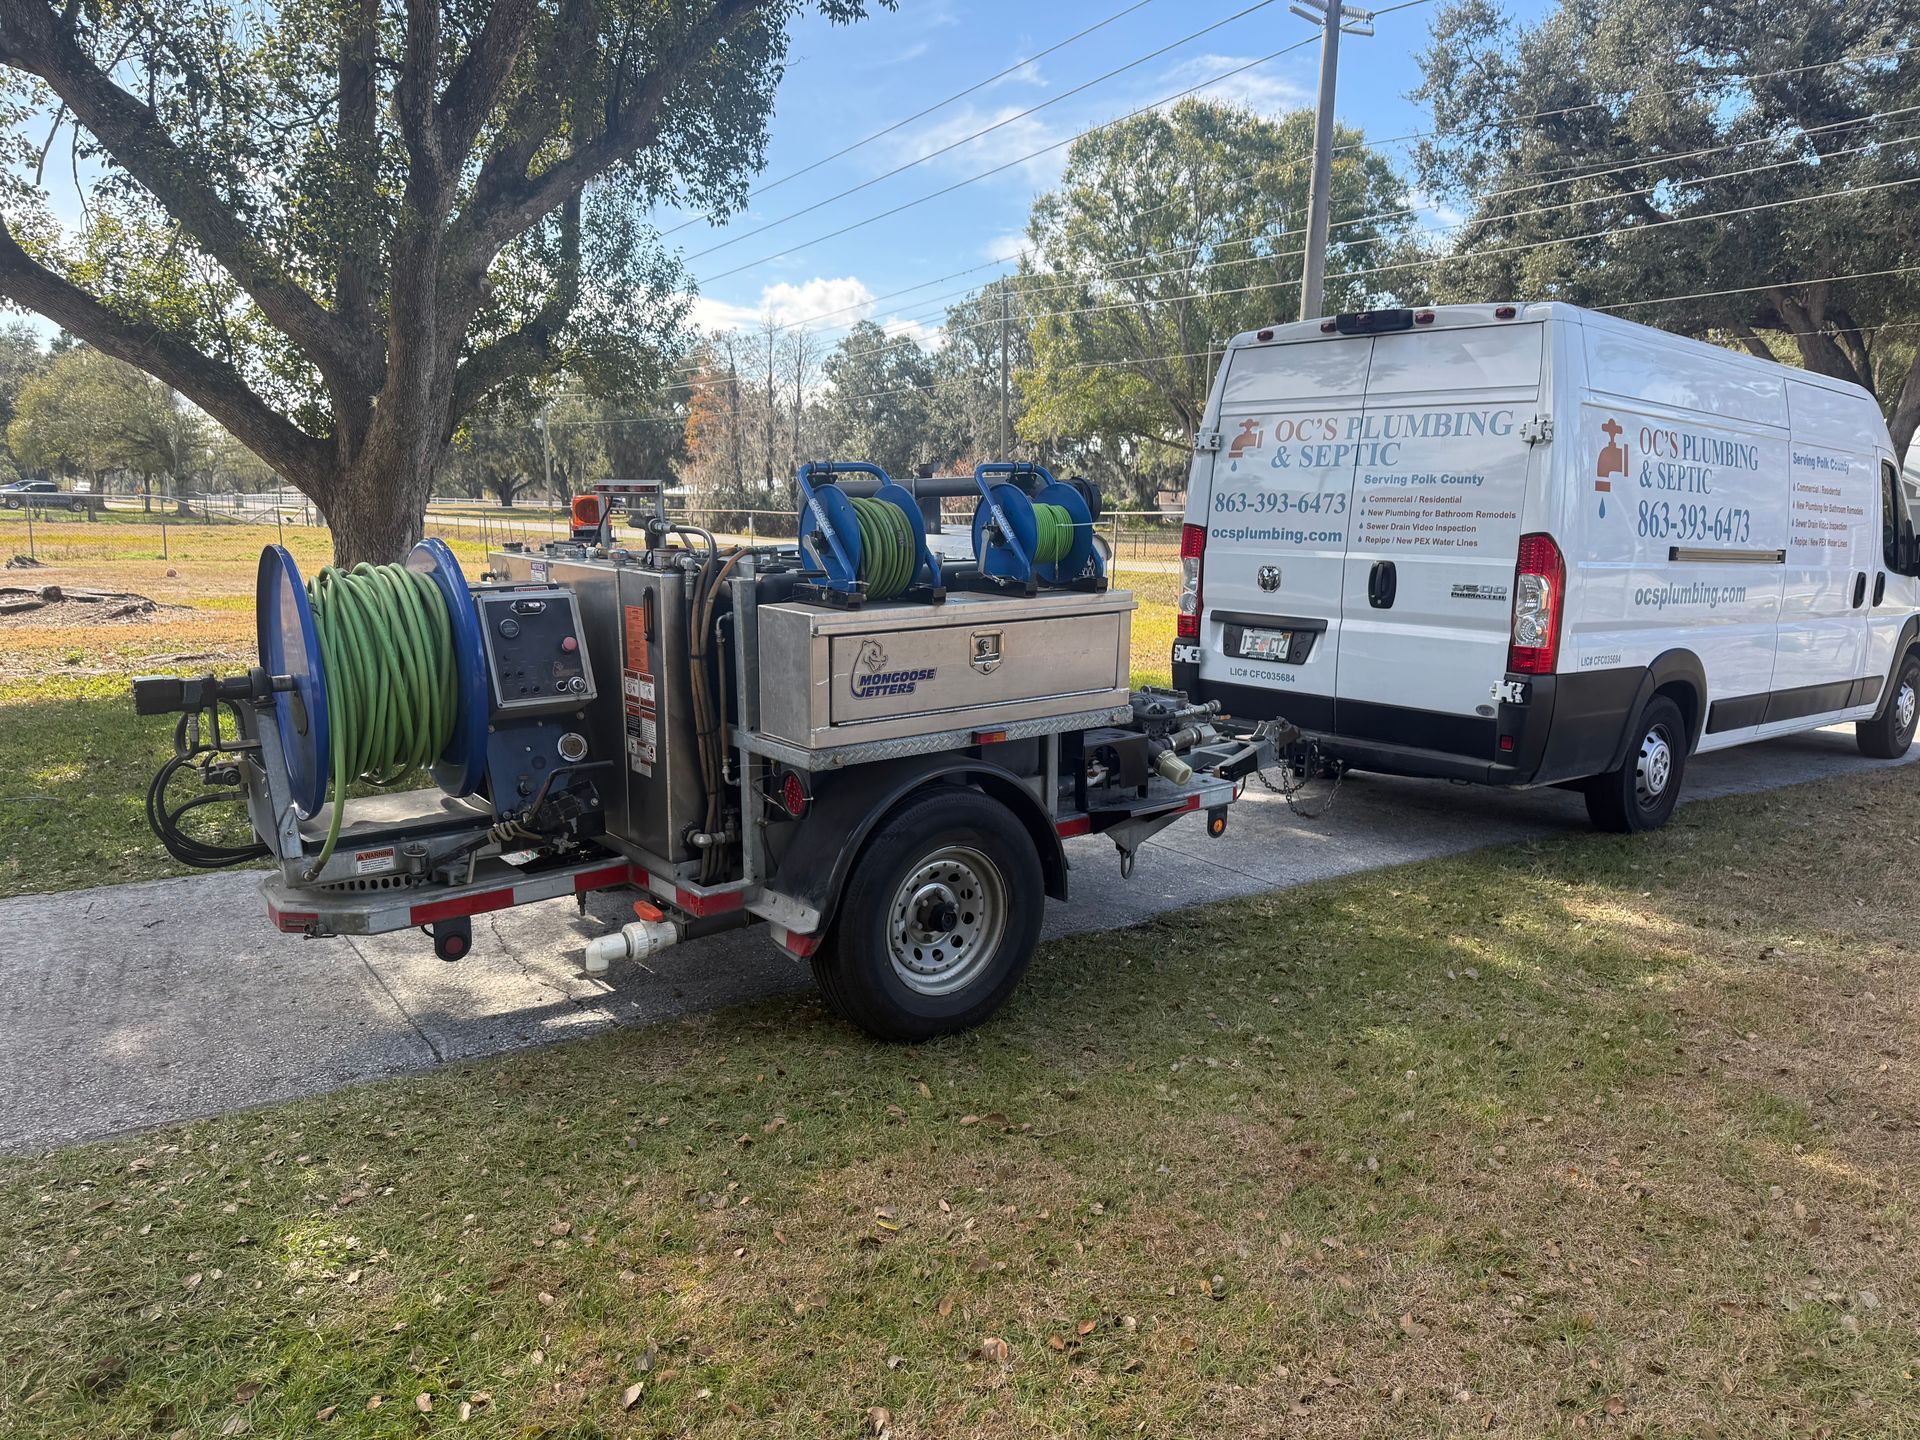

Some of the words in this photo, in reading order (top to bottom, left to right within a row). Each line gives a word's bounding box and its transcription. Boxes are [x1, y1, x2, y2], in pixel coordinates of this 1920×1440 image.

[1274, 417, 1338, 442] OC'S
[1344, 410, 1514, 440] PLUMBING
[1271, 445, 1291, 468] &
[1299, 442, 1401, 468] SEPTIC
[1640, 427, 1678, 459] OC'S
[1682, 433, 1758, 471] PLUMBING
[1793, 452, 1815, 470] Serving
[1364, 474, 1407, 486] Serving
[1411, 474, 1437, 484] Polk
[1440, 473, 1485, 487] County
[1640, 460, 1652, 488] &
[1657, 461, 1713, 494] SEPTIC
[1215, 492, 1347, 514] 863-393-6473
[1369, 495, 1413, 503] Commercial
[1419, 495, 1462, 504] Residential
[1367, 509, 1383, 517] New
[1385, 509, 1420, 519] Plumbing
[1435, 510, 1474, 518] Bathroom
[1475, 511, 1517, 519] Remodels
[1638, 500, 1750, 543] 863-393-6473
[1211, 526, 1343, 544] ocsplumbing.com
[1390, 523, 1411, 531] Drain
[1412, 523, 1434, 531] Video
[1435, 524, 1477, 533] Inspection
[1365, 536, 1390, 545] Repipe
[1396, 537, 1412, 545] New
[1414, 537, 1430, 545] PEX
[1432, 538, 1455, 546] Water
[1456, 539, 1478, 547] Lines
[1634, 582, 1747, 610] ocsplumbing.com
[859, 669, 936, 686] MONGOOSE
[1230, 667, 1247, 677] LIC#
[1249, 669, 1295, 682] CFC035684
[857, 682, 916, 698] JETTERS
[364, 848, 394, 860] WARNING
